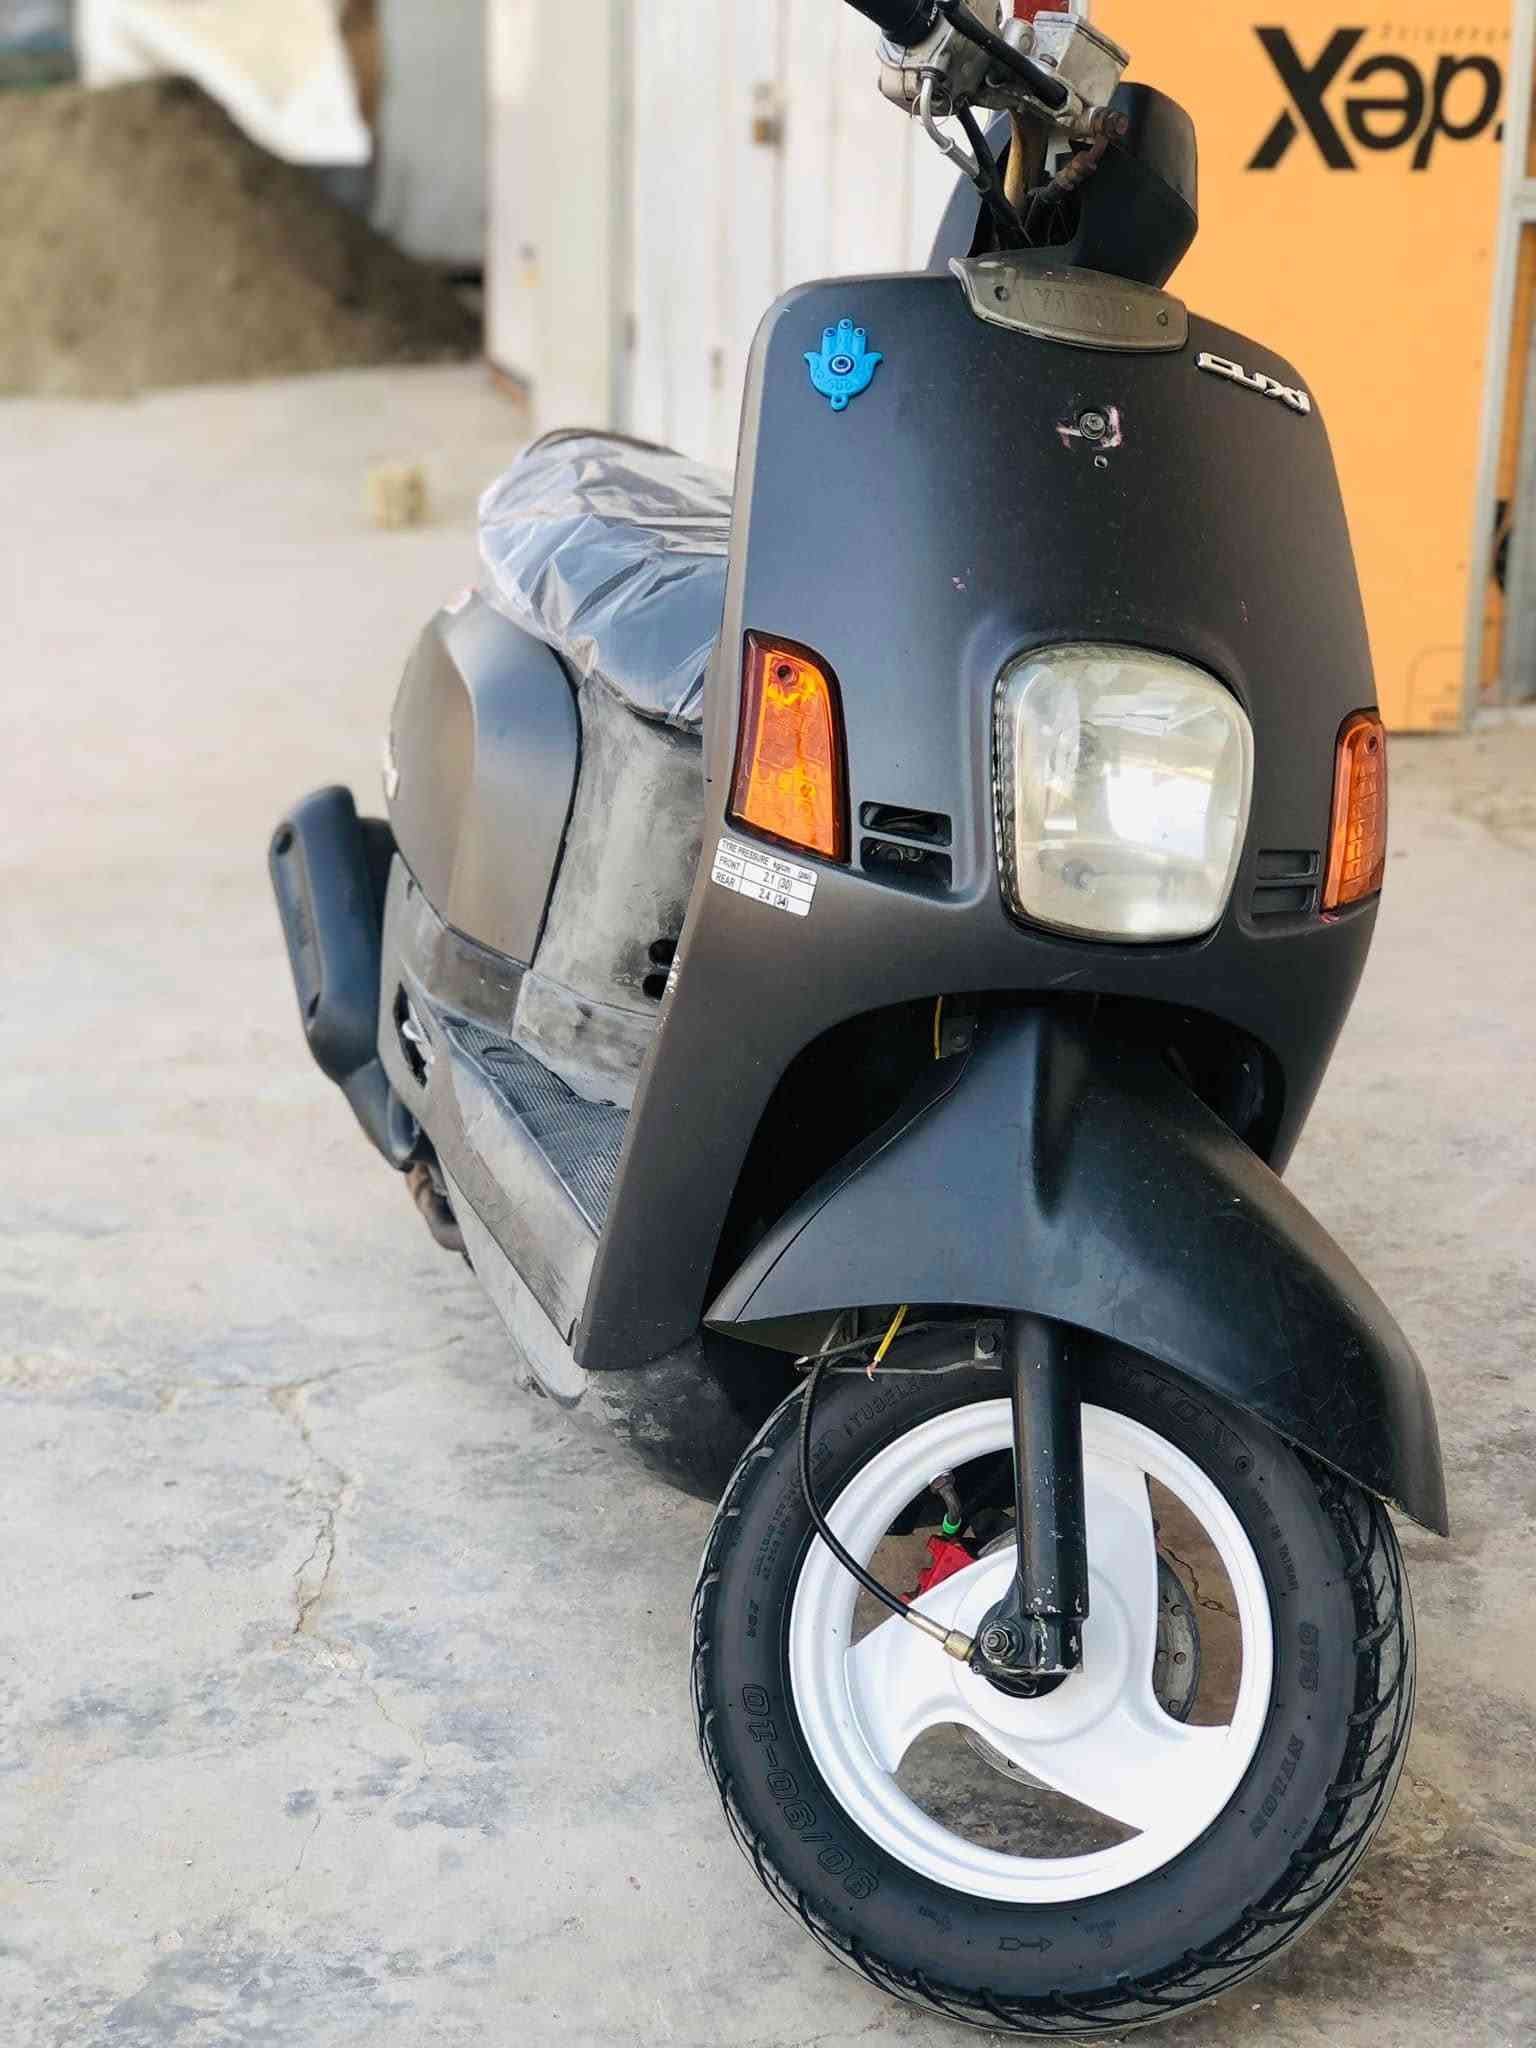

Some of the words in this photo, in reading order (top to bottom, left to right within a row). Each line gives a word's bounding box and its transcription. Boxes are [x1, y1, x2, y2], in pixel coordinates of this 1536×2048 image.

[718, 855, 741, 871] FRONT
[736, 845, 771, 866] PRESSURE
[714, 871, 736, 886] REAR
[742, 1683, 879, 1899] 90/90-10
